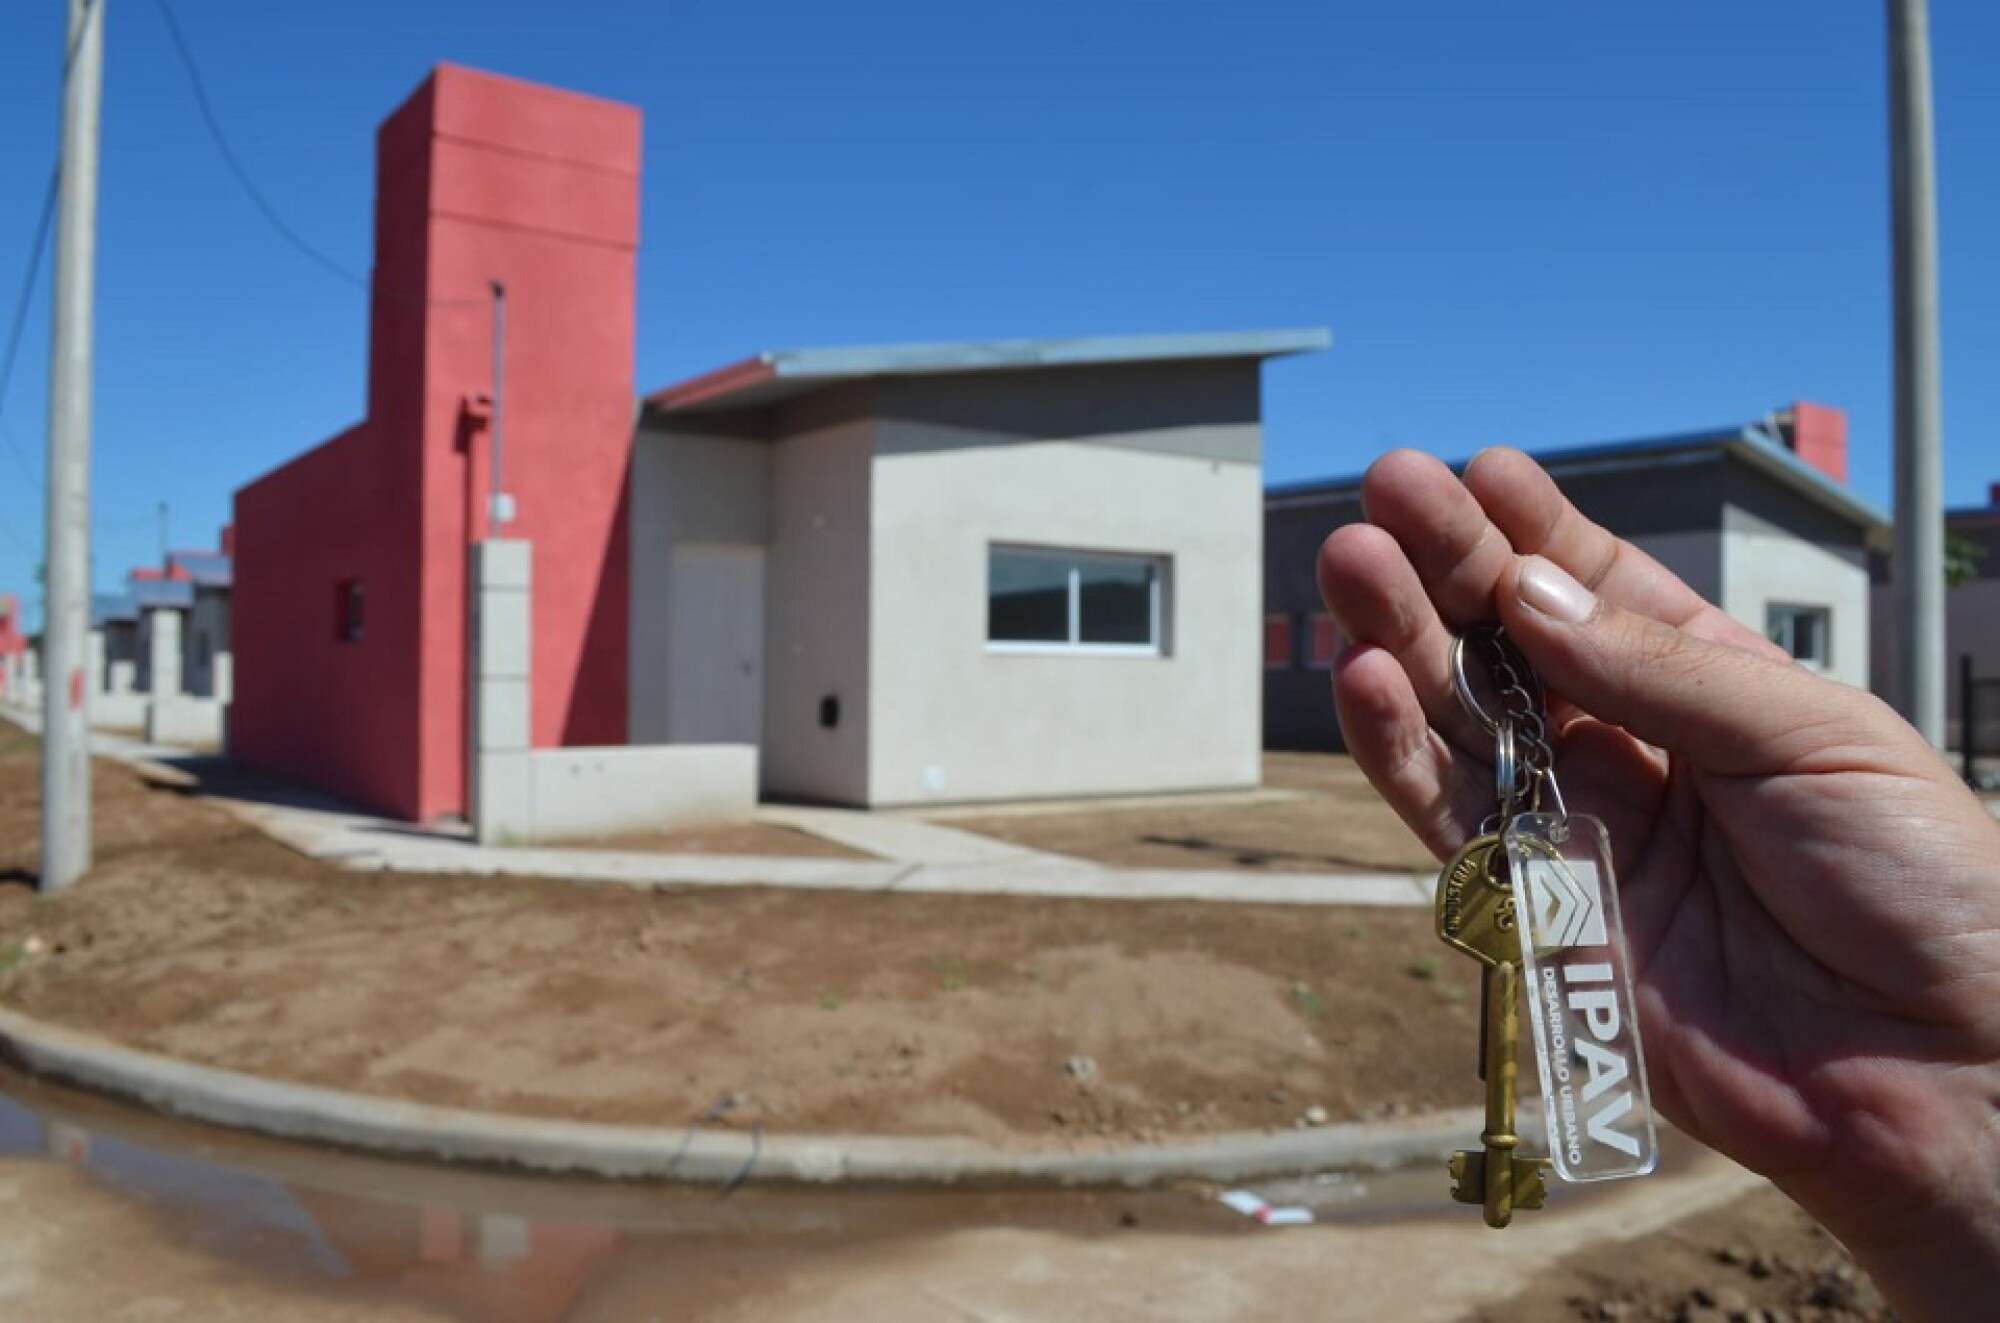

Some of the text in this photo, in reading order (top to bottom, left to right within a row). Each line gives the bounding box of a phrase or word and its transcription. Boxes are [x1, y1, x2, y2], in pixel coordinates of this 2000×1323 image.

[1543, 966, 1582, 1166] DESARROLLO URBANO
[1563, 963, 1641, 1157] IPAV
